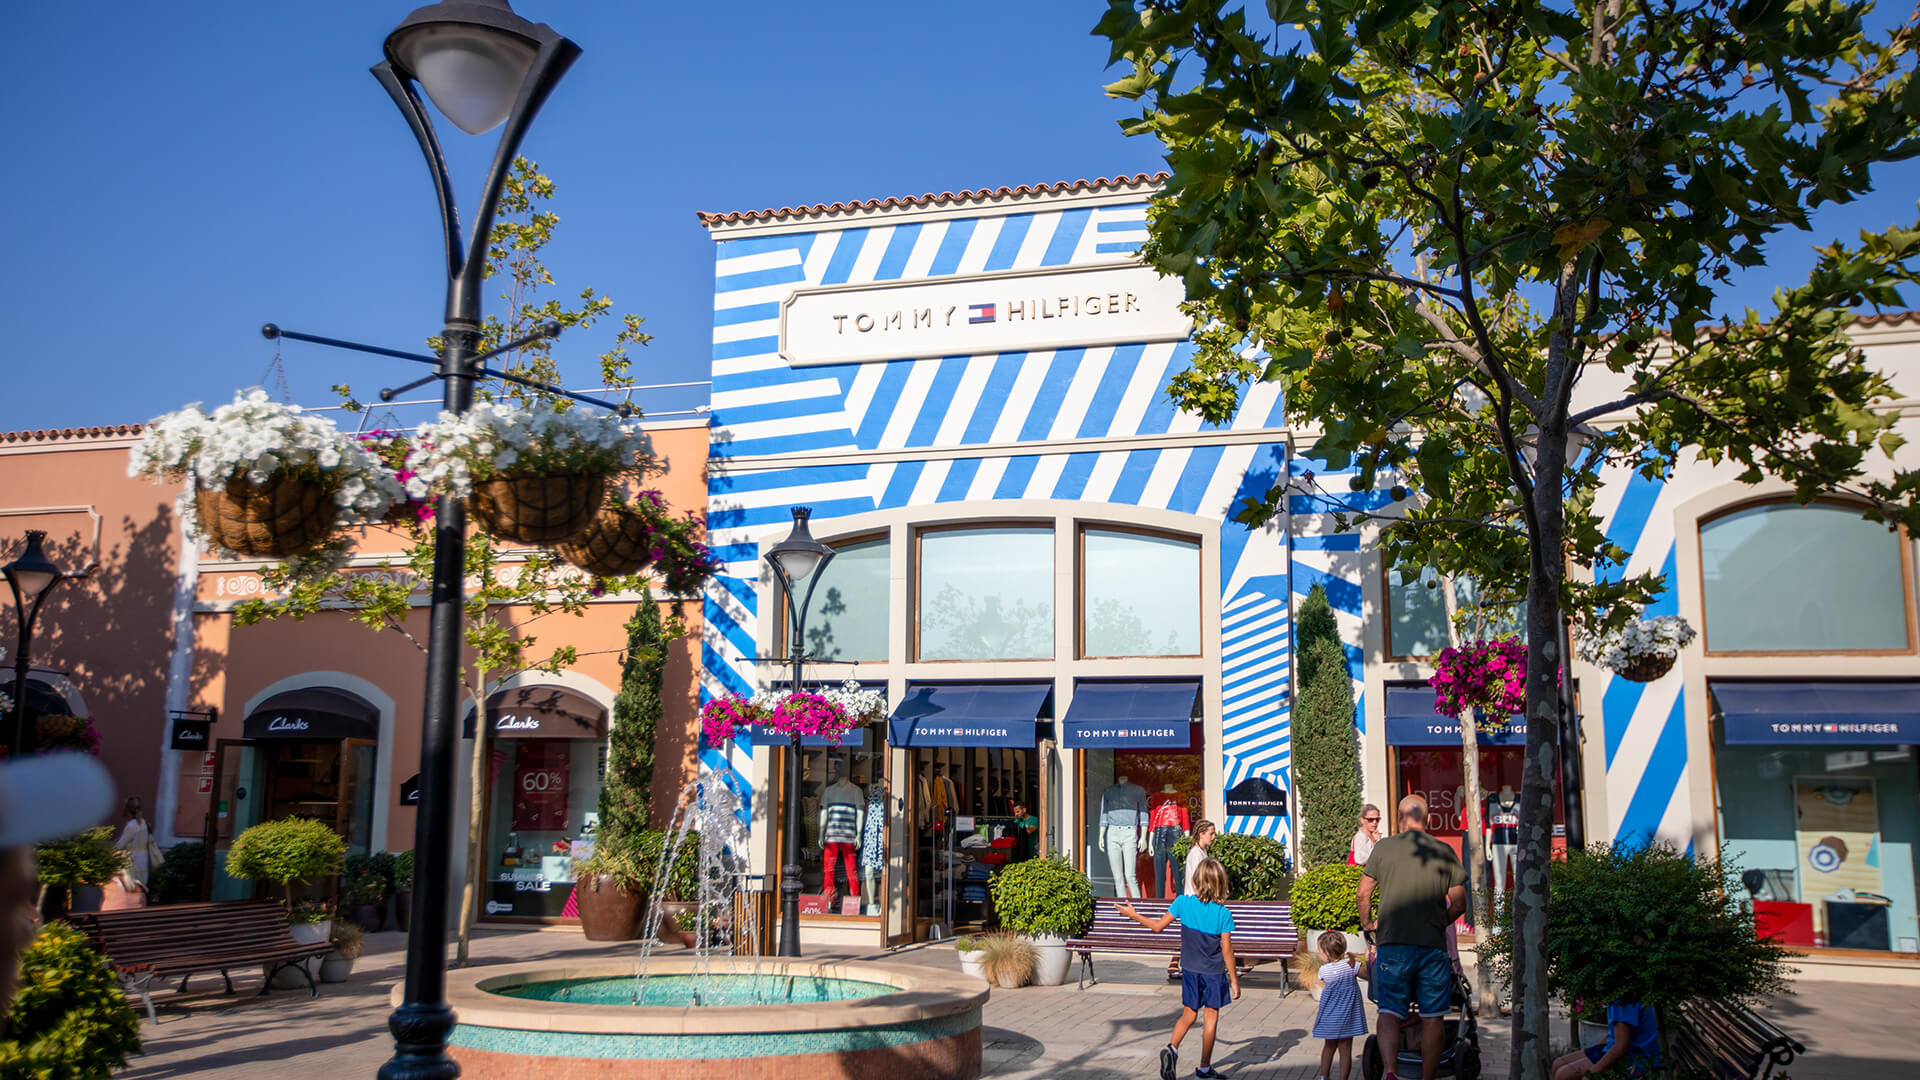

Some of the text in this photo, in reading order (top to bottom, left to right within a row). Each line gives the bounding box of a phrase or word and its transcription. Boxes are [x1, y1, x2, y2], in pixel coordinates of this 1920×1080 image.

[833, 291, 1141, 335] TOMMY HILFIGER
[268, 717, 309, 730] Clarks
[496, 715, 540, 729] Clarks
[915, 728, 1008, 736] TOMMY HILFIGER
[1130, 729, 1175, 737] HILFIGER
[1427, 726, 1462, 734] TOMM
[1770, 723, 1899, 734] TOMMY HILFIGER
[522, 771, 562, 791] 60%
[516, 881, 552, 891] SALE
